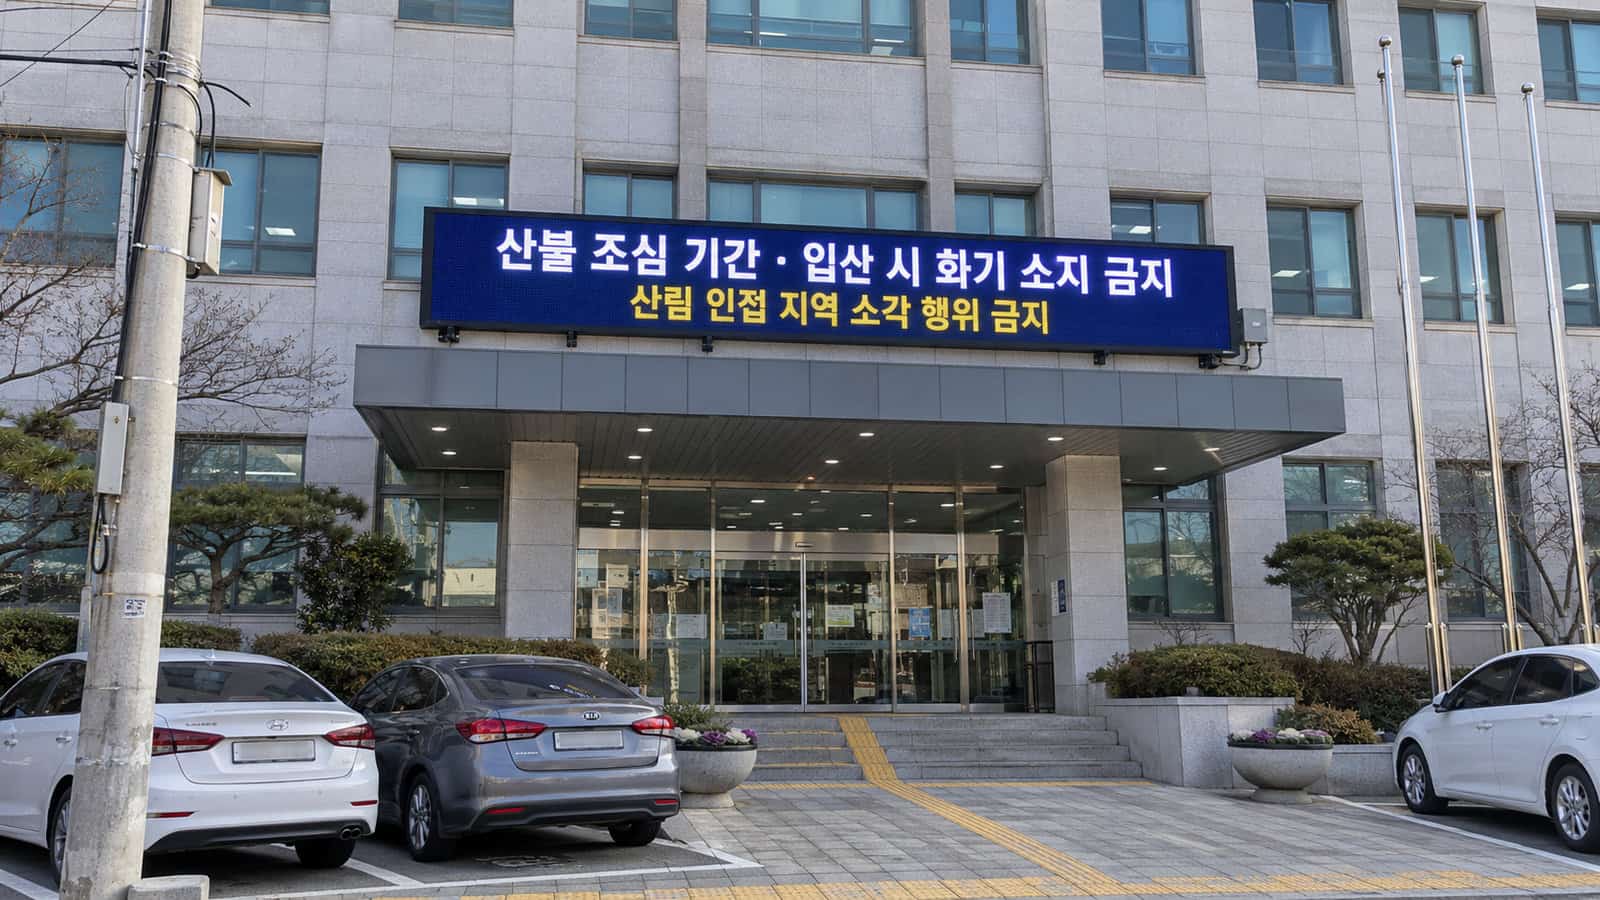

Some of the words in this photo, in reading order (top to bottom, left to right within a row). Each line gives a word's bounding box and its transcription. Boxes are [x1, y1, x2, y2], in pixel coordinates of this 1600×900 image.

[497, 228, 577, 274] 산불
[591, 234, 667, 277] 조심
[684, 238, 761, 280] 기간
[803, 242, 875, 285] 입산
[886, 247, 920, 288] 시
[935, 248, 1005, 291] 화기
[1020, 253, 1089, 294] 소지
[1104, 256, 1174, 299] 금지
[630, 285, 692, 321] 산림
[706, 287, 766, 324] 인접
[780, 291, 838, 328] 지역
[850, 294, 912, 330] 소각
[921, 296, 979, 333] 행위
[991, 299, 1049, 335] 금지
[583, 711, 600, 720] KIA
